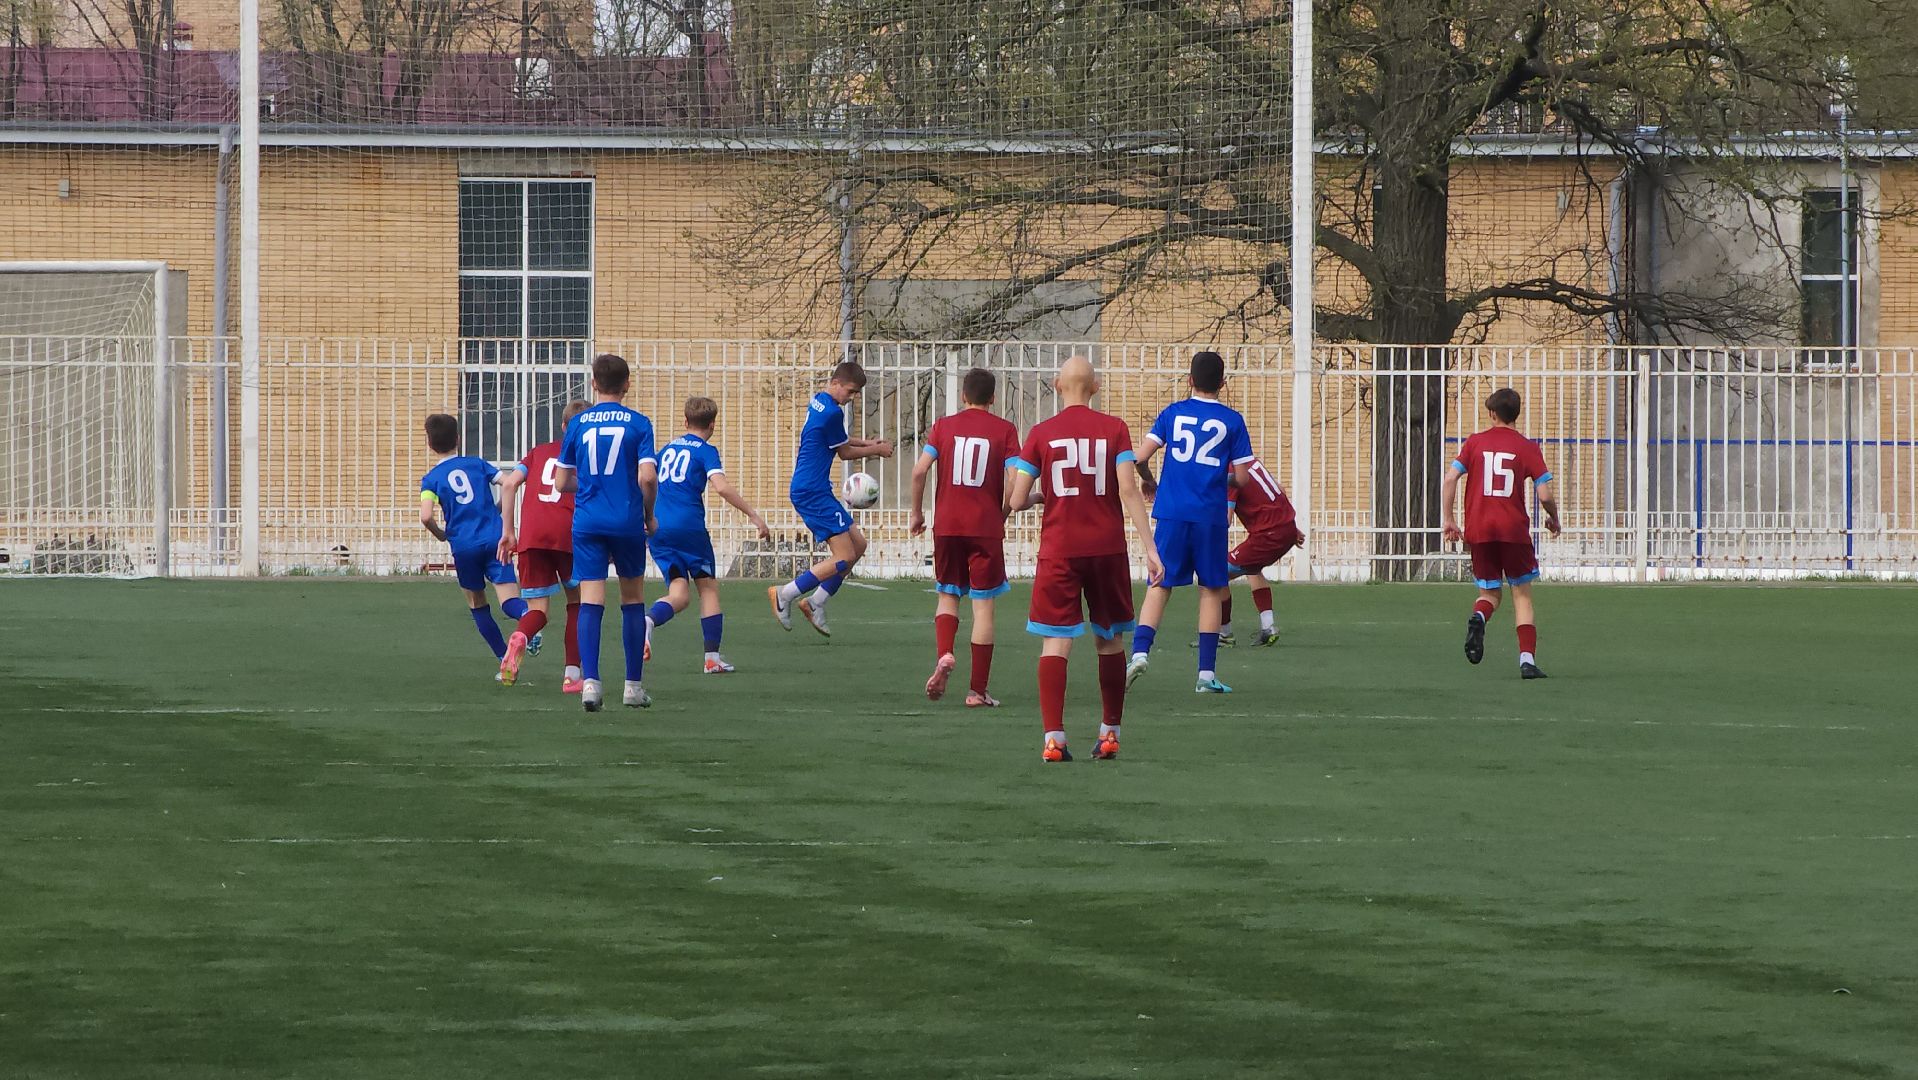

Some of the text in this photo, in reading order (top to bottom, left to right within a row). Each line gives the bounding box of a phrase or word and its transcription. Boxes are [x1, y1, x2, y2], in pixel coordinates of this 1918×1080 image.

[580, 411, 631, 423] ФЕДОТОВ
[582, 426, 625, 475] 17
[952, 435, 990, 487] 10
[1172, 415, 1227, 467] 52
[447, 469, 474, 504] 9
[658, 447, 690, 483] 80
[1049, 438, 1107, 497] 24
[1247, 461, 1281, 501] 17
[1482, 451, 1516, 497] 15
[835, 511, 845, 527] 2
